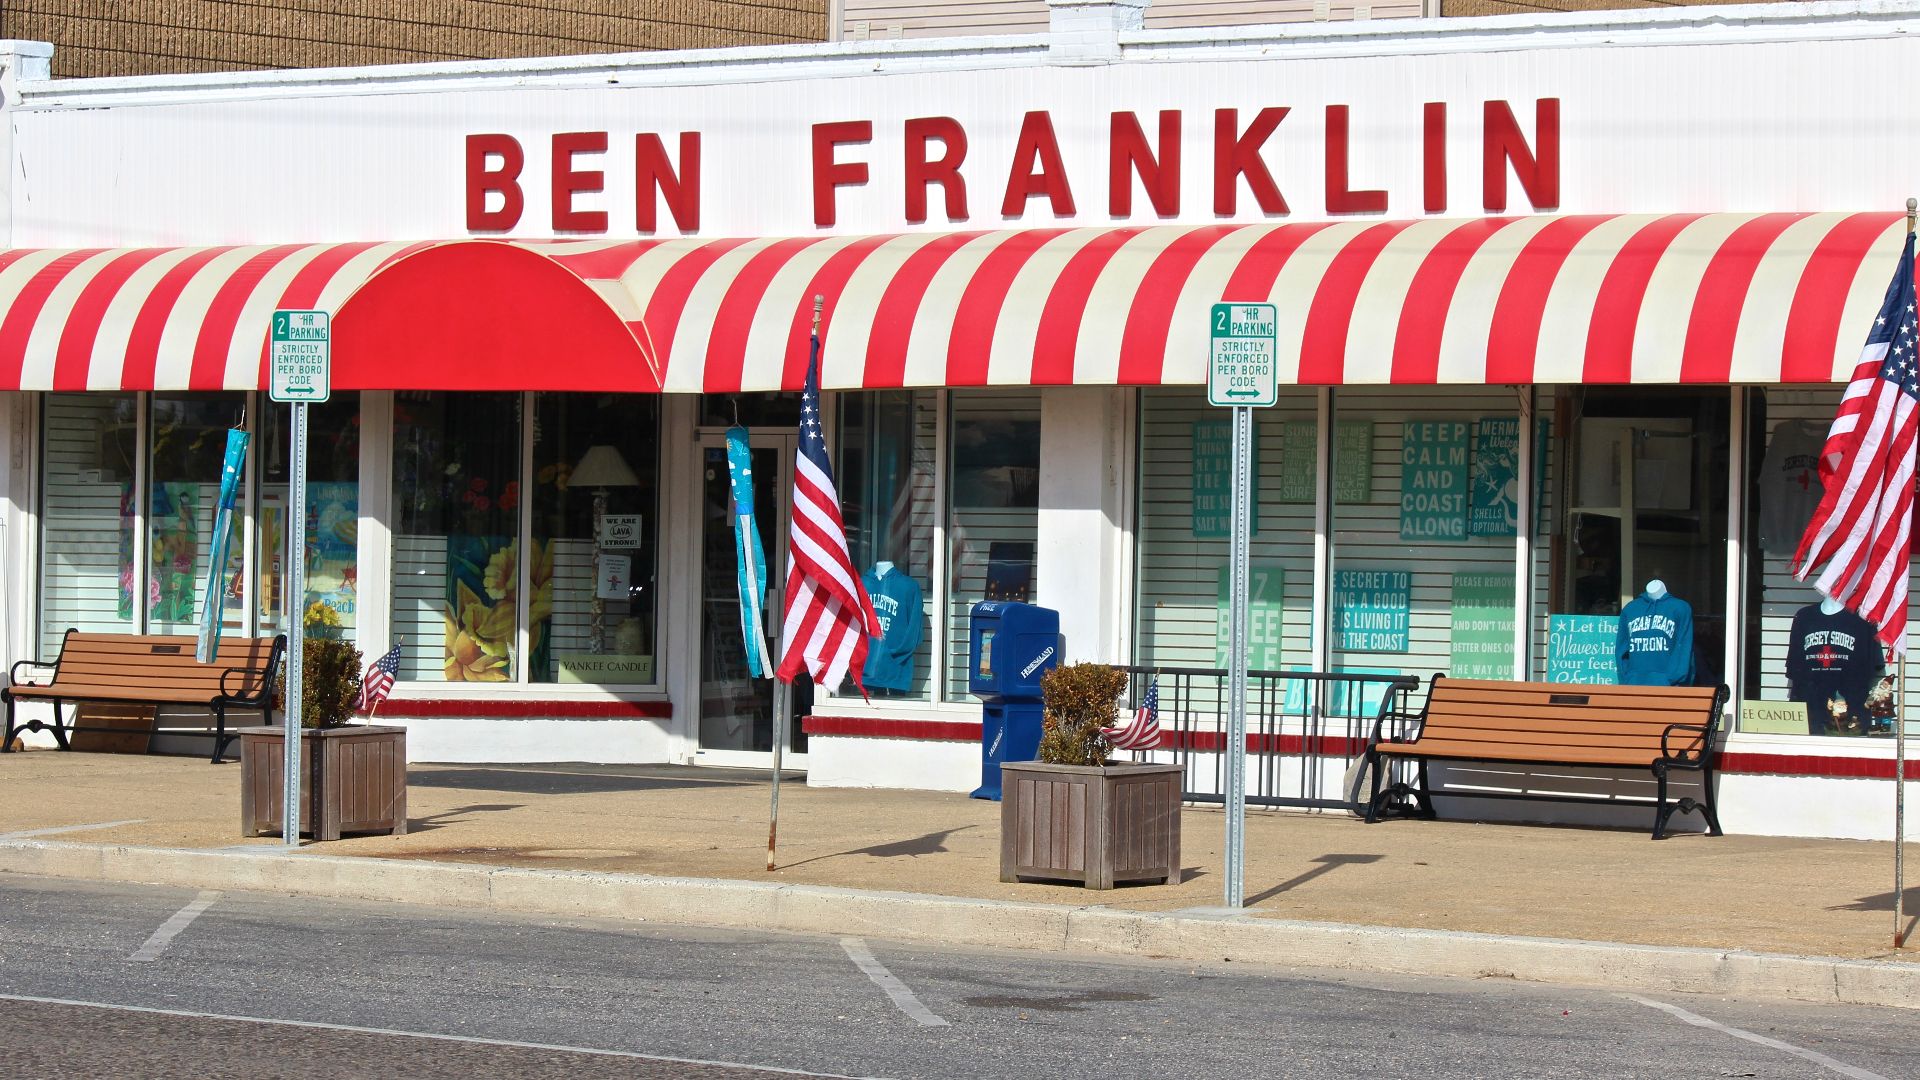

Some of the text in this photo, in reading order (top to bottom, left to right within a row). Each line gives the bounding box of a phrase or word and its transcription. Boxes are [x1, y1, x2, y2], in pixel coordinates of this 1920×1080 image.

[466, 98, 1559, 234] BEN FRANKLIN
[277, 315, 314, 334] 2 HR
[1217, 308, 1258, 330] 2 HR
[290, 328, 326, 338] PARKING
[1232, 322, 1272, 335] PARKING
[282, 345, 319, 354] STRICTLY
[1222, 342, 1264, 352] STRICTLY
[278, 355, 322, 364] ENFORCED
[1218, 354, 1268, 364] ENFORCED
[278, 366, 322, 374] PER BORO
[1218, 366, 1268, 375] PER BORO
[289, 376, 311, 384] CODE
[1230, 378, 1256, 386] CODE
[1404, 424, 1466, 442] KEEP
[1404, 448, 1464, 464] CALM
[1413, 470, 1452, 488] AND
[1336, 490, 1362, 500] NSET
[1197, 496, 1215, 510] THE
[1402, 494, 1464, 512] COAST
[1474, 508, 1502, 518] SHELLS
[1196, 517, 1216, 531] SALT
[1402, 517, 1463, 536] ALONG
[1473, 522, 1508, 532] OPTIONAL
[612, 528, 630, 536] LAVA
[1342, 572, 1388, 589] SECRET
[1393, 573, 1407, 589] TO
[1454, 577, 1481, 586] PLEASE
[1360, 593, 1368, 608] A
[1374, 593, 1406, 609] GOOD
[1455, 600, 1480, 608] YOUR
[1218, 608, 1278, 644] BEE
[1340, 612, 1350, 628] IS
[1354, 612, 1390, 630] LIVING
[1395, 614, 1405, 630] IT
[1454, 621, 1470, 630] AND
[1472, 622, 1494, 631] DON'T
[1570, 620, 1618, 633] Let the
[1349, 633, 1368, 649] THE
[1370, 634, 1404, 650] COAST
[1550, 633, 1600, 658] Waves
[1804, 631, 1856, 651] JERSEY SHORE
[1453, 643, 1479, 652] BETTER
[1482, 644, 1502, 653] ONES
[564, 661, 648, 672] YANKEE CANDLE
[1452, 666, 1468, 674] THE
[1473, 665, 1493, 674] WAY
[1552, 659, 1584, 671] your
[1757, 710, 1805, 722] CANDLE
